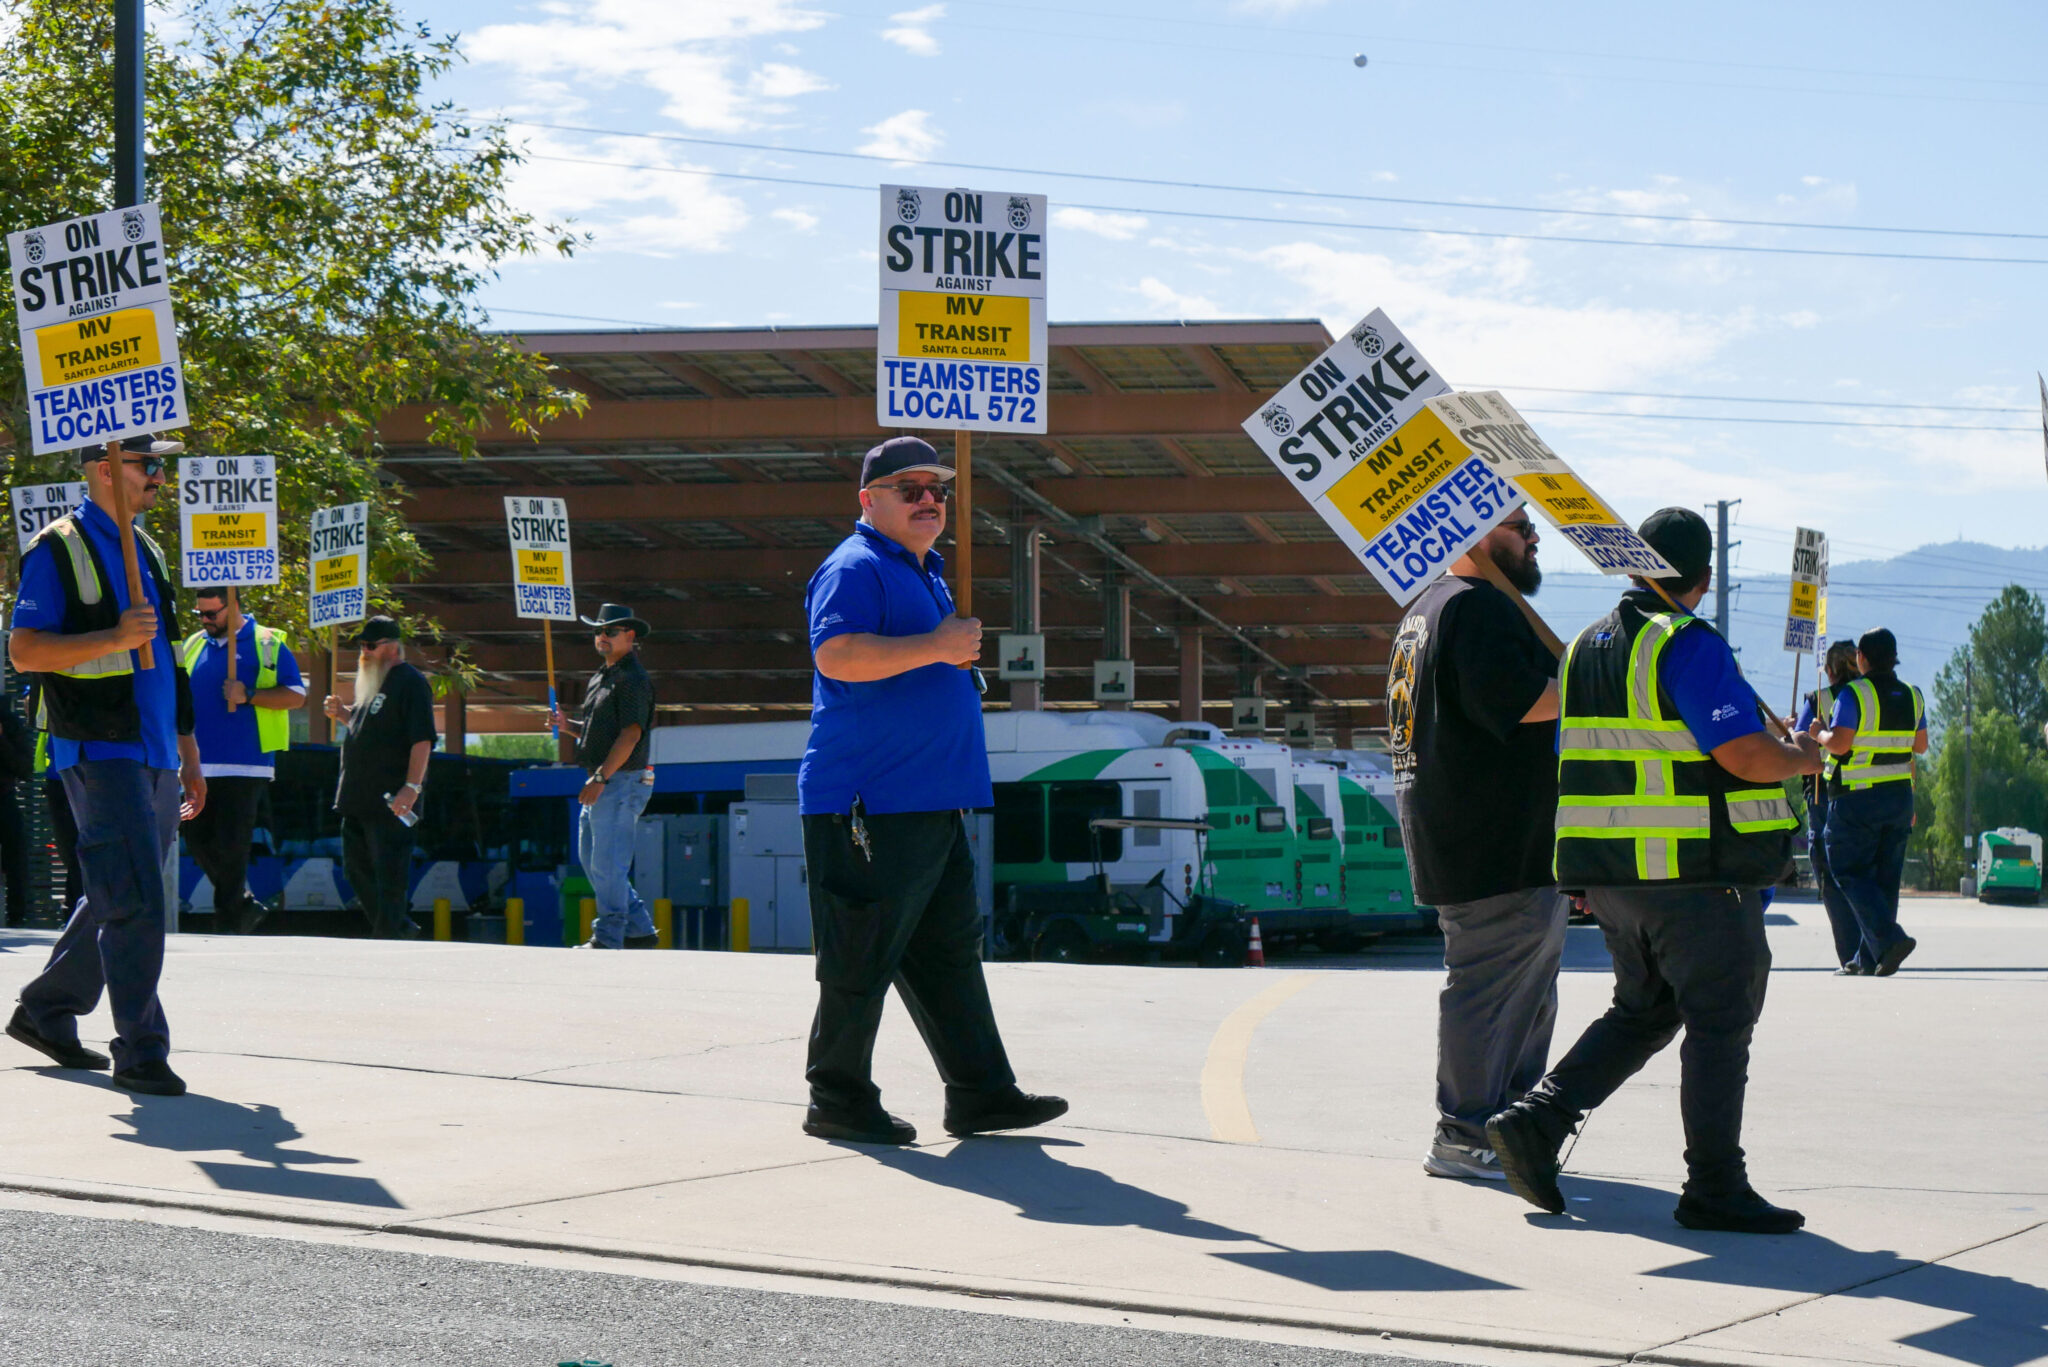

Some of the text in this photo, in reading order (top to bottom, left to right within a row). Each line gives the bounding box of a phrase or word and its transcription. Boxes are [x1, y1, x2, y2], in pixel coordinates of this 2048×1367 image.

[944, 192, 982, 224] ON
[65, 219, 100, 252] ON
[886, 224, 1041, 280] STRIKE
[20, 241, 162, 311] STRIKE
[935, 276, 992, 292] AGAINST
[68, 295, 118, 317] AGAINST
[946, 297, 984, 316] MV
[78, 317, 112, 340] MV
[915, 323, 1012, 343] TRANSIT
[55, 336, 142, 369] TRANSIT
[922, 344, 1006, 357] SANTA CLARITA
[64, 357, 139, 381] SANTA CLARITA
[884, 360, 1040, 395] TEAMSTERS
[1299, 356, 1346, 402] ON
[34, 366, 177, 418] TEAMSTERS
[888, 390, 1036, 423] LOCAL 572
[1278, 341, 1430, 482] STRIKE
[42, 395, 177, 445] LOCAL 572
[1348, 415, 1399, 461] AGAINST
[1460, 423, 1559, 465] STRIKE
[1366, 436, 1406, 476] MV
[217, 459, 239, 476] ON
[1359, 438, 1446, 516] TRANSIT
[184, 477, 273, 505] STRIKE
[1379, 459, 1453, 523] SANTA CLARITA
[1538, 476, 1562, 490] MV
[46, 486, 67, 503] ON
[1546, 498, 1594, 511] TRANSIT
[331, 508, 344, 524] ON
[529, 499, 544, 515] ON
[1364, 457, 1495, 571] TEAMSTER
[218, 515, 241, 525] MV
[511, 517, 567, 543] STRIKE
[201, 529, 256, 540] TRANSIT
[313, 522, 364, 553] STRIKE
[1560, 527, 1646, 547] TEAMSTERS
[186, 549, 275, 566] TEAMSTERS
[329, 558, 343, 569] MV
[532, 552, 547, 562] MV
[1386, 522, 1477, 593] LOCAL
[1583, 549, 1667, 571] LOCAL 572
[1793, 548, 1819, 577] STRIK
[189, 565, 273, 582] LOCAL 572
[320, 570, 352, 583] TRANSIT
[524, 565, 558, 575] TRANSIT
[312, 588, 364, 609] TEAMSTERS
[517, 585, 572, 601] TEAMSTERS
[313, 602, 362, 623] LOCAL 572
[520, 599, 572, 616] LOCAL 572
[1788, 617, 1816, 636] TEAMSTERS
